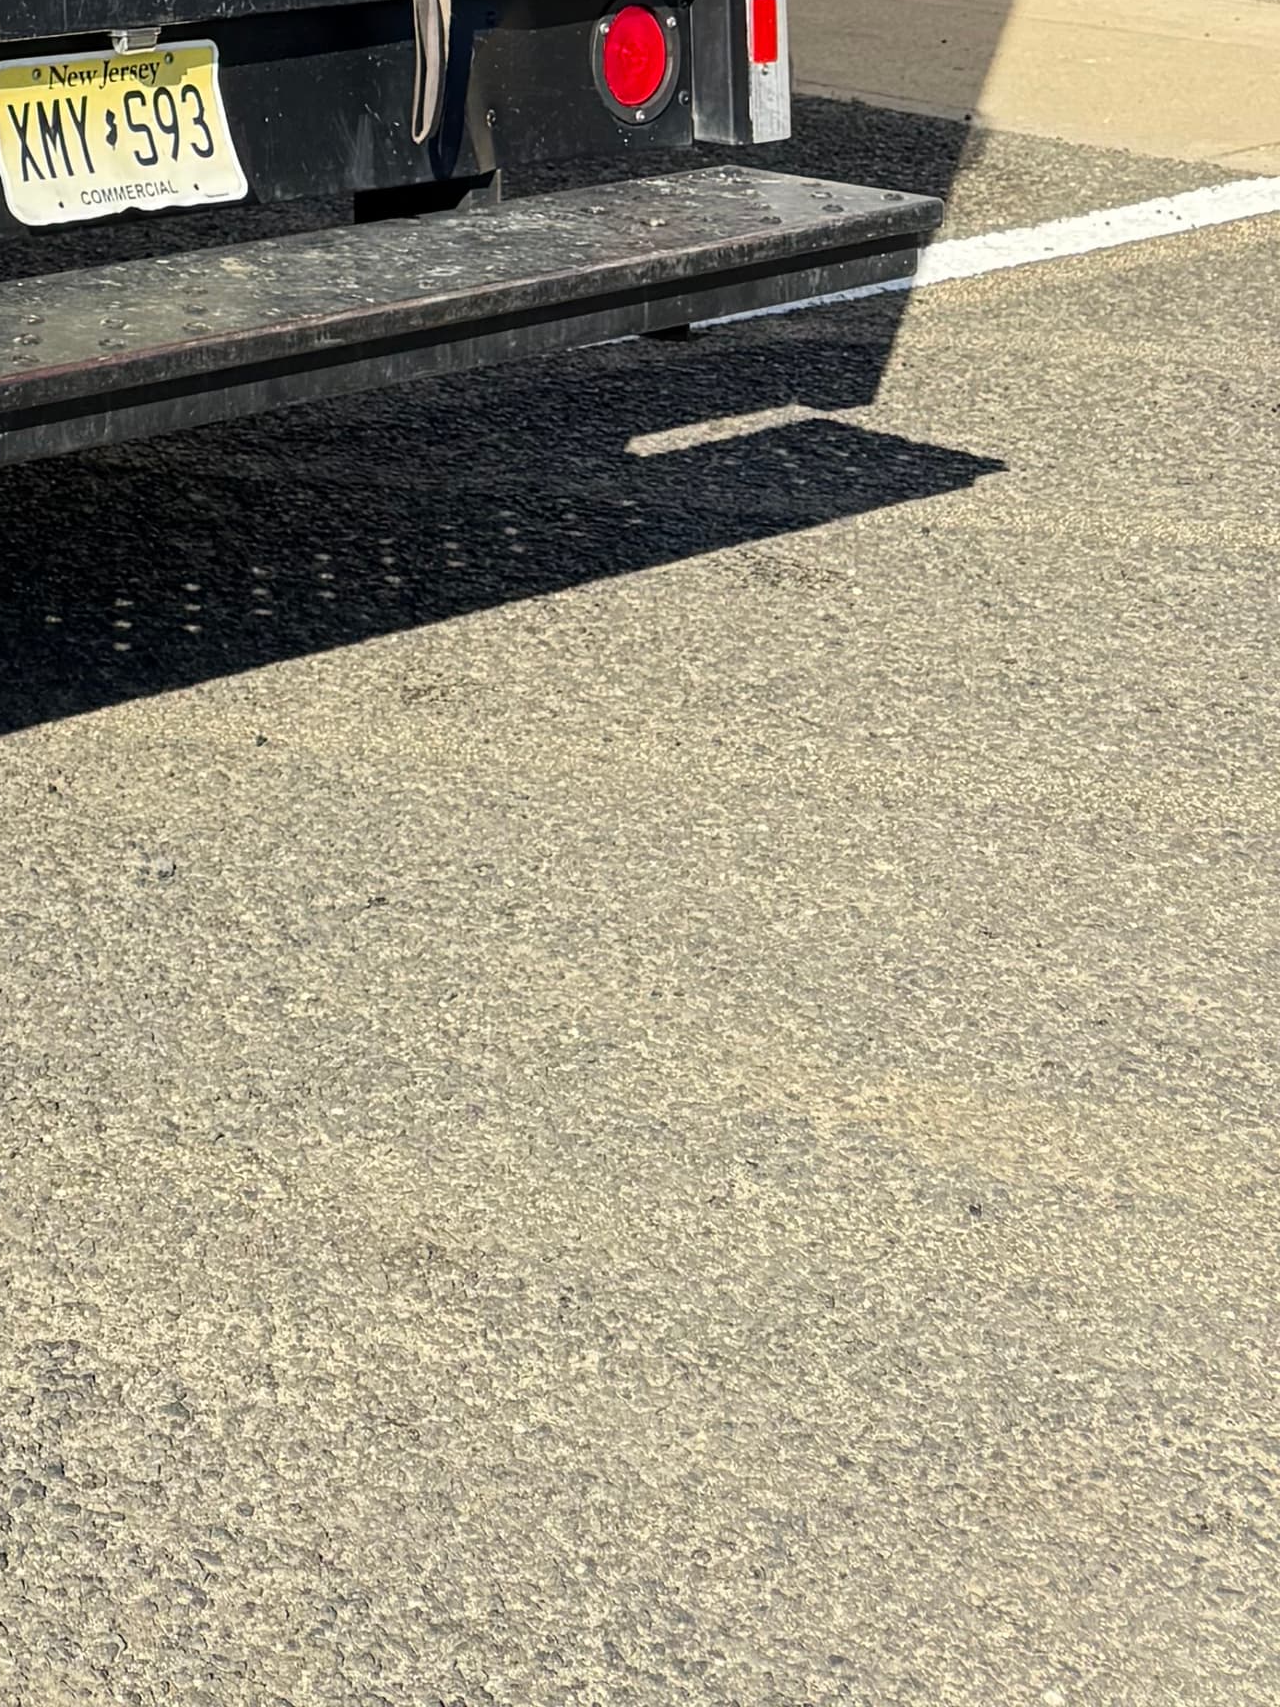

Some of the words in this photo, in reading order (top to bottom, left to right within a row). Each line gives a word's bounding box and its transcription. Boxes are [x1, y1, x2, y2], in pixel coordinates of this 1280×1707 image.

[49, 64, 96, 89] New
[99, 59, 161, 89] Jersey
[7, 96, 95, 182] XMY
[80, 181, 178, 205] COMMERCIAL
